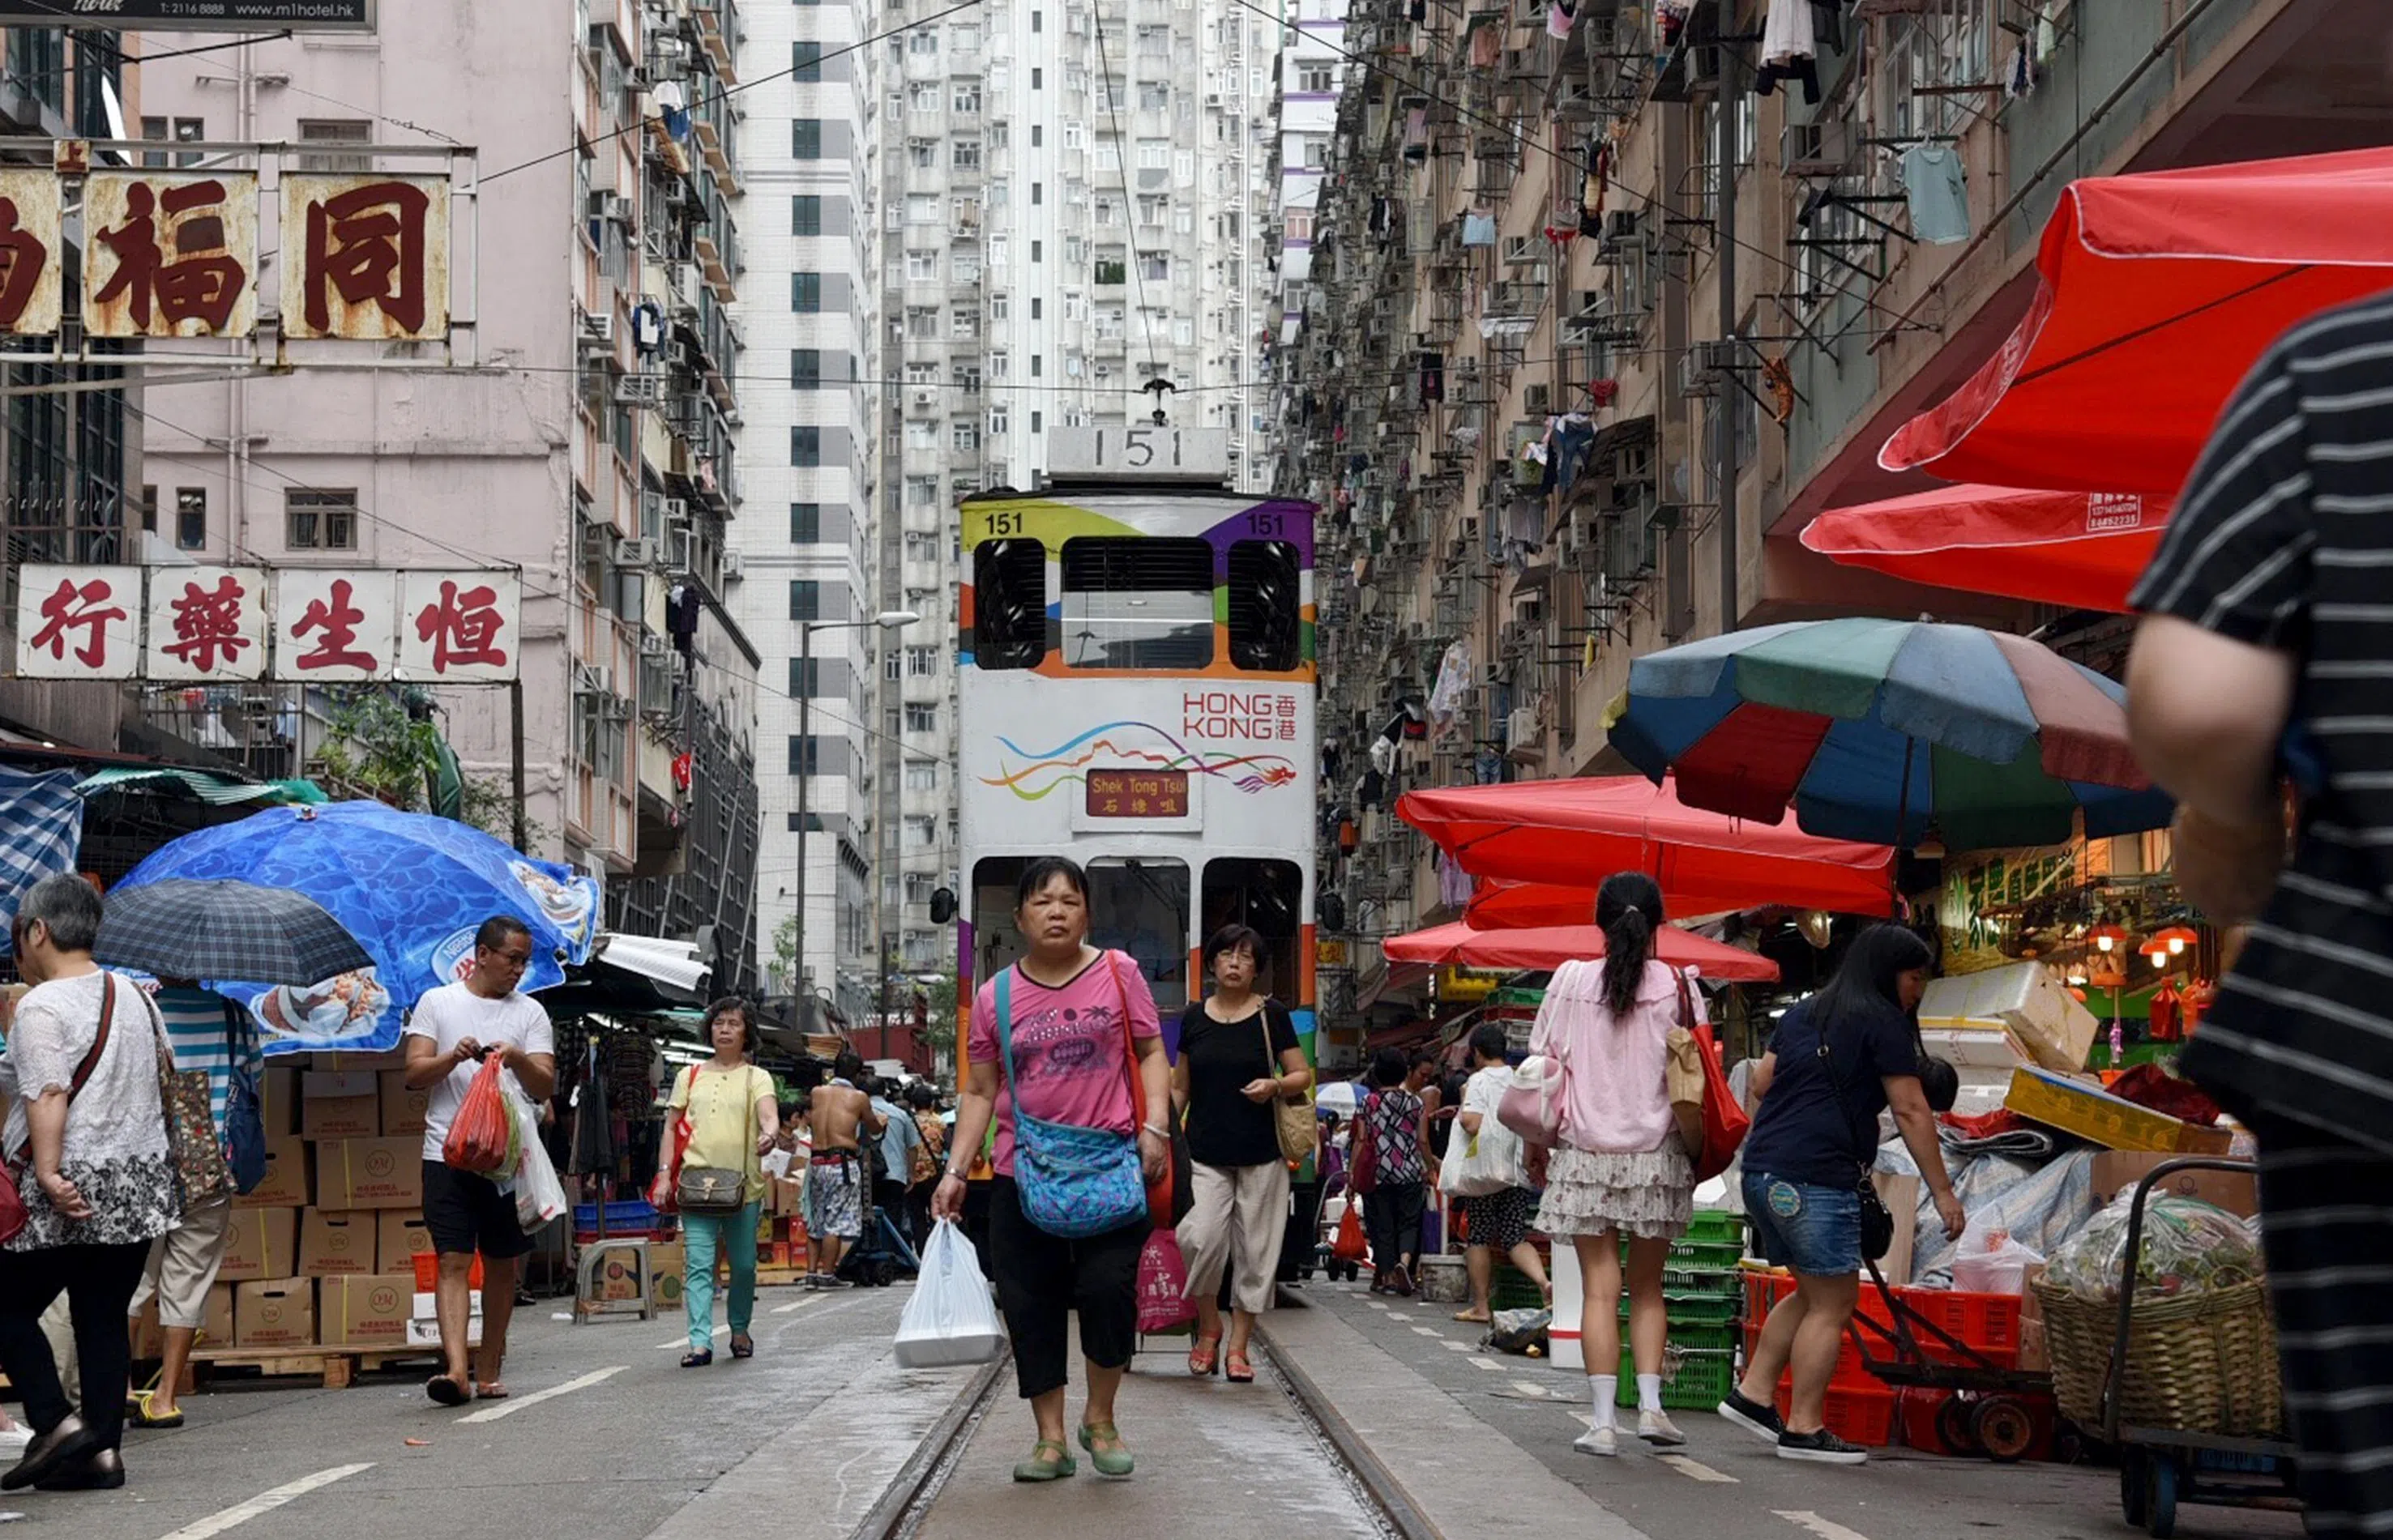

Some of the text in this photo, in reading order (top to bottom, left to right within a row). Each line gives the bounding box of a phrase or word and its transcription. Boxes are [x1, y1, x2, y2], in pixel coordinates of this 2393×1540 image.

[172, 3, 197, 15] 2116
[235, 3, 355, 17] www.m1hotel.hk
[1096, 429, 1182, 467] 151
[985, 513, 1023, 535] 151
[1247, 513, 1284, 535] 151
[1183, 693, 1272, 715] HONG
[1183, 717, 1272, 740] KONG
[1092, 777, 1186, 797] Shek Tong Tsui
